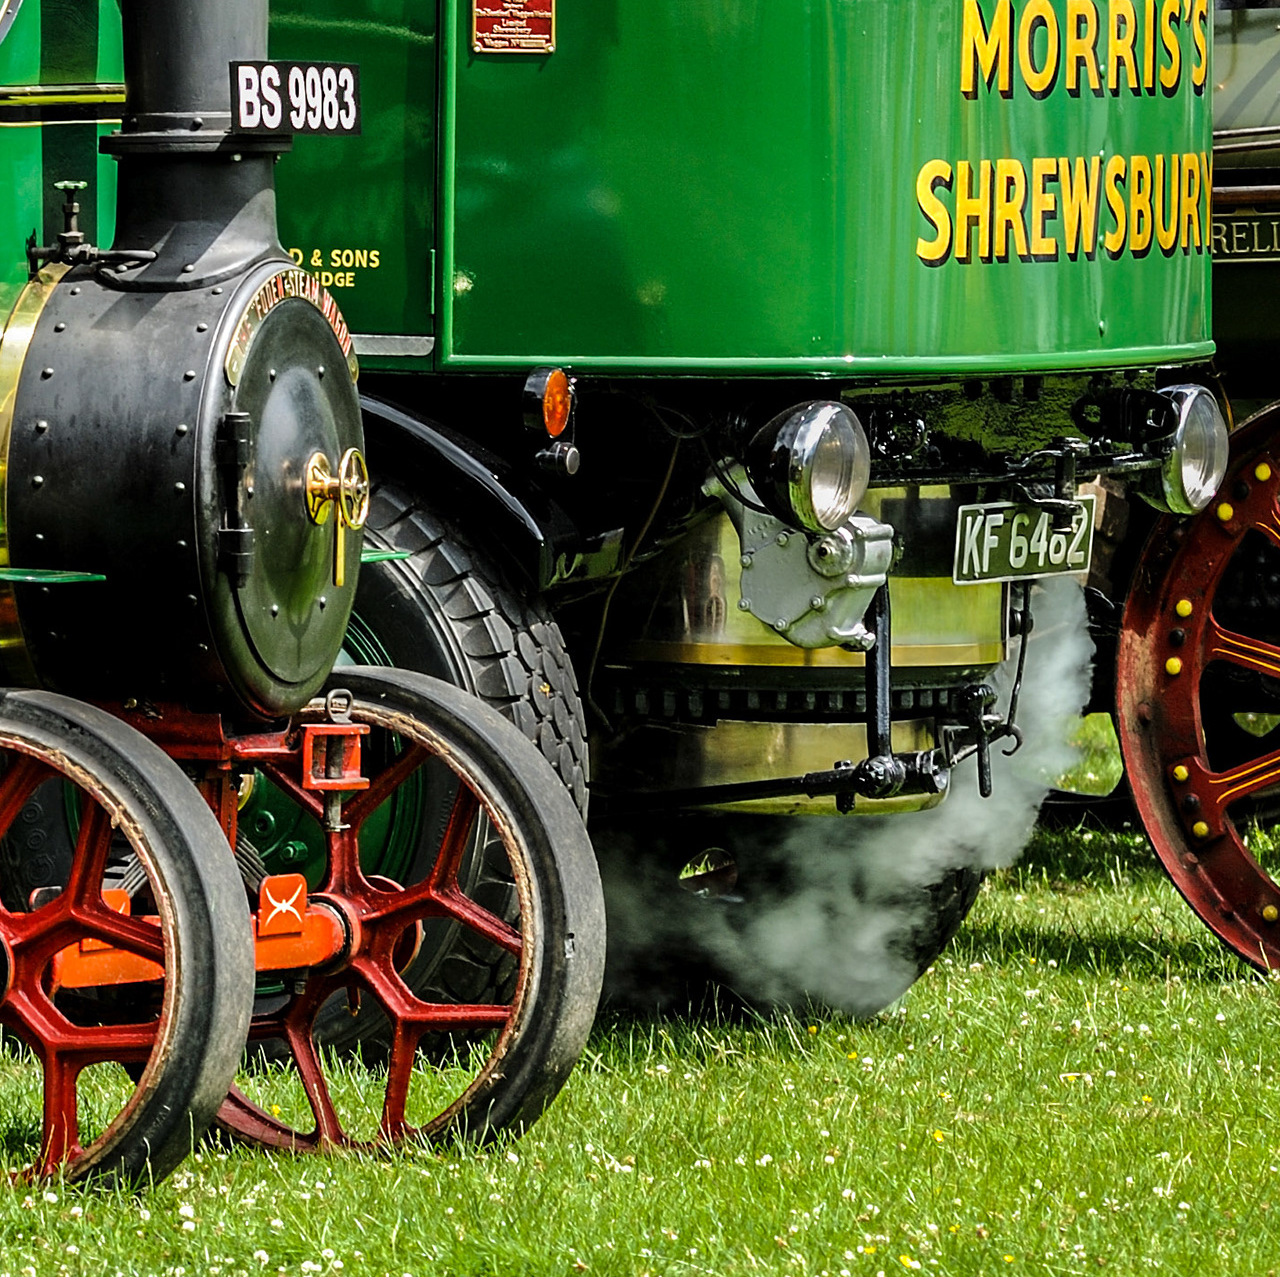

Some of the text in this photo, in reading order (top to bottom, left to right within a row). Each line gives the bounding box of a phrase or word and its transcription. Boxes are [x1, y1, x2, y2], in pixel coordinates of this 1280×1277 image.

[237, 64, 357, 131] BS 9983
[915, 151, 1214, 262] SHREWSBURY
[288, 269, 320, 306] STEAM
[310, 248, 323, 267] &
[330, 248, 381, 269] SONS
[962, 510, 1005, 576] KF
